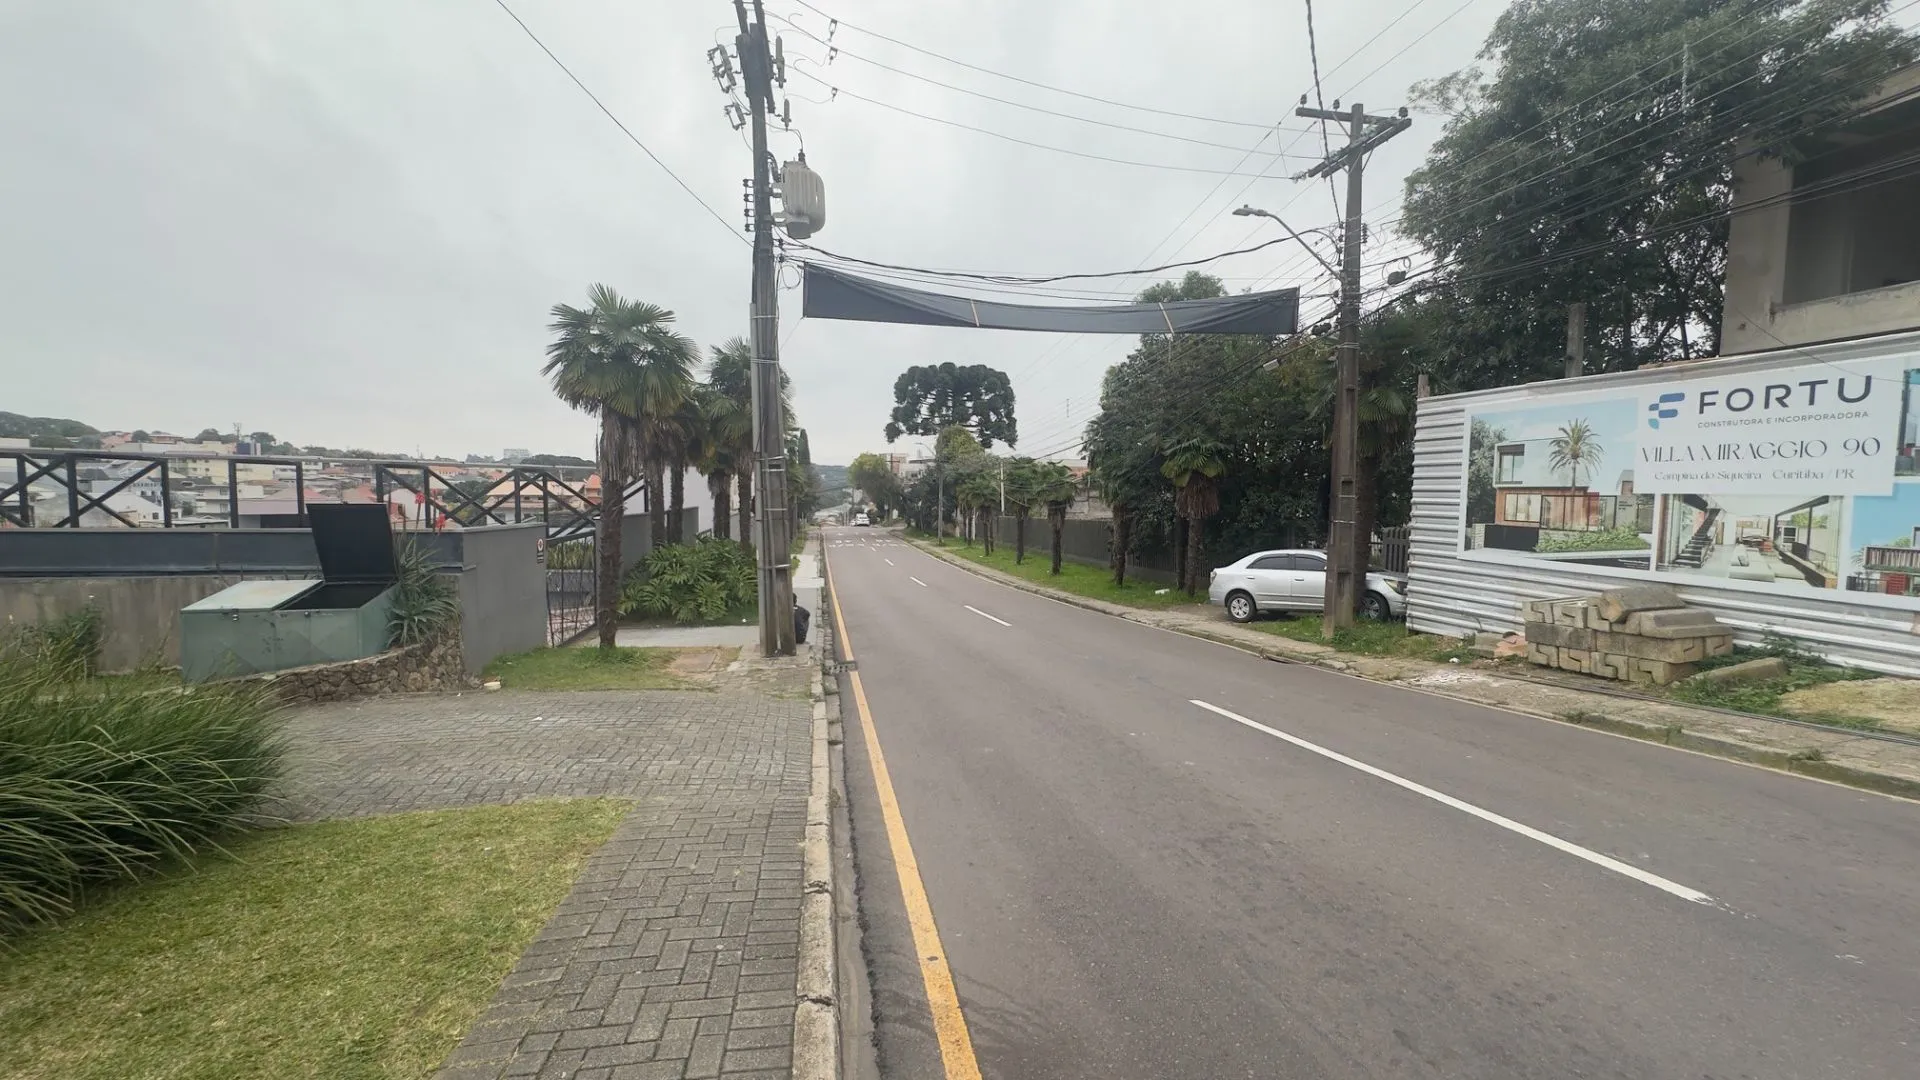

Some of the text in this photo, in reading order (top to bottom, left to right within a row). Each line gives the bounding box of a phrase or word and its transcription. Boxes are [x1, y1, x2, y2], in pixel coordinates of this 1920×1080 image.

[1699, 375, 1872, 414] FORTU
[1698, 418, 1763, 428] CONSTRUTORA
[1775, 411, 1869, 423] INCORPORADORA
[1843, 437, 1880, 456] 90
[1772, 468, 1824, 480] Curitiba
[1835, 467, 1855, 480] PR
